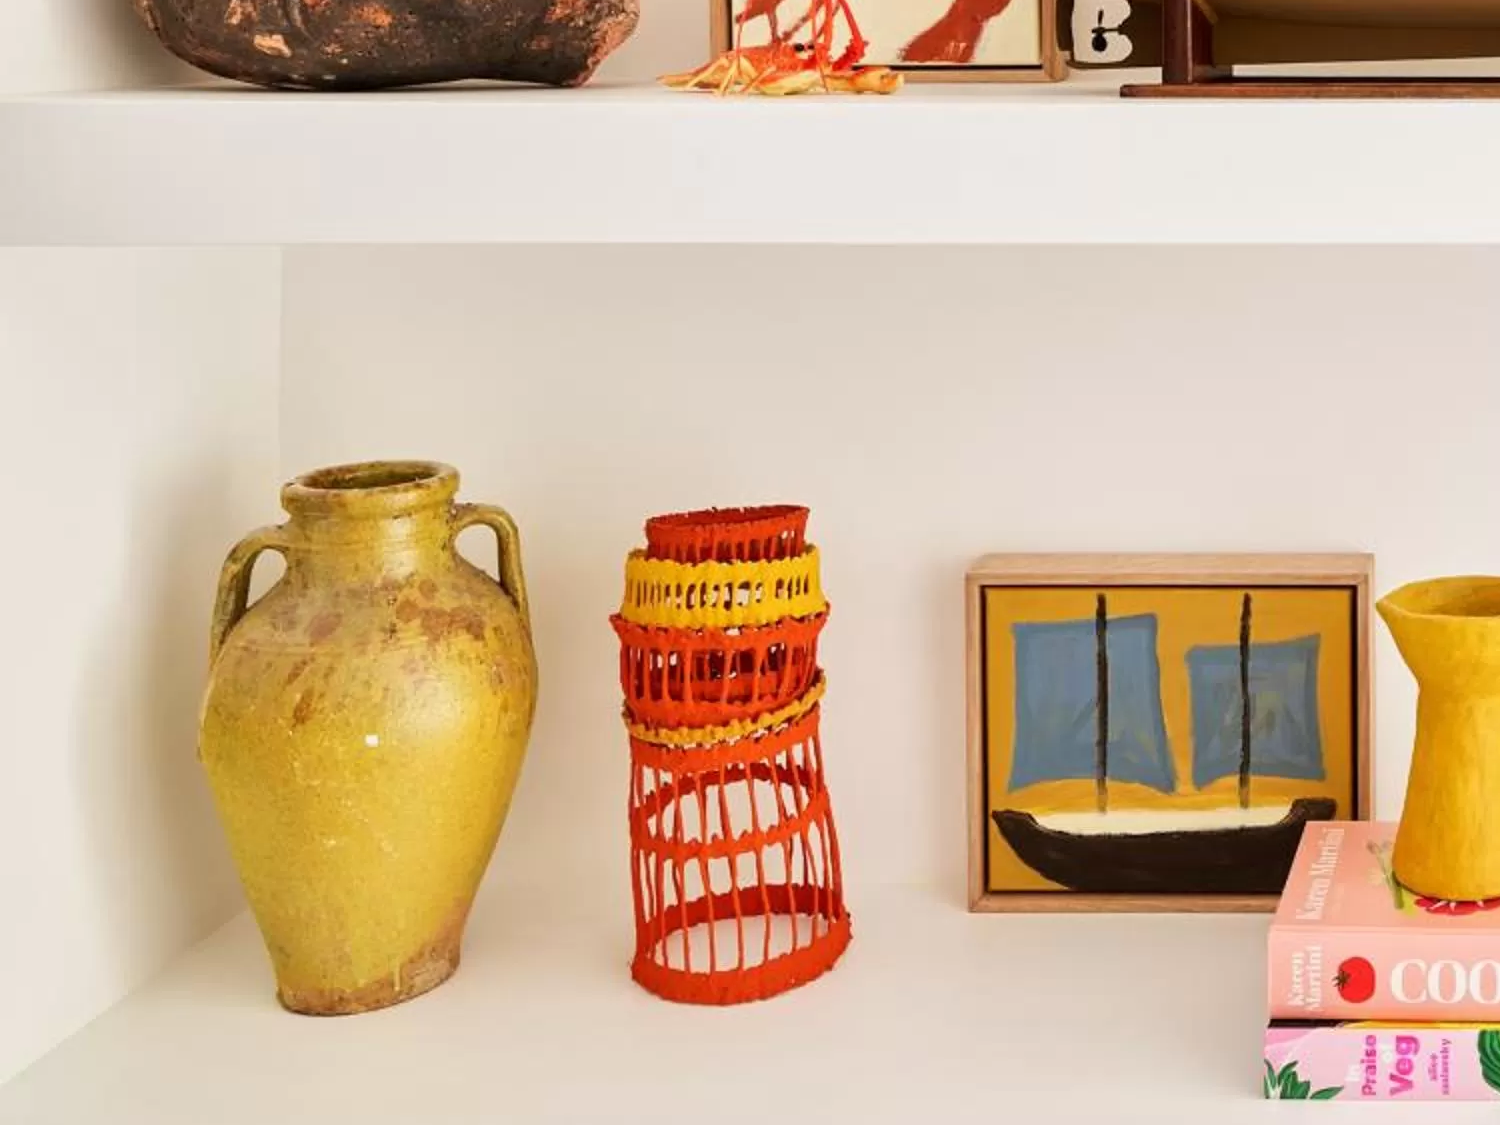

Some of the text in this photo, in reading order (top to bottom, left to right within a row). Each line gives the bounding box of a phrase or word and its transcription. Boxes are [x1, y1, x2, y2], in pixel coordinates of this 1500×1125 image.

[1296, 879, 1330, 920] Karen
[1287, 952, 1304, 1006] Karen
[1304, 946, 1321, 1011] Martini
[1361, 1035, 1376, 1095] Praise
[1389, 1035, 1420, 1096] Veg
